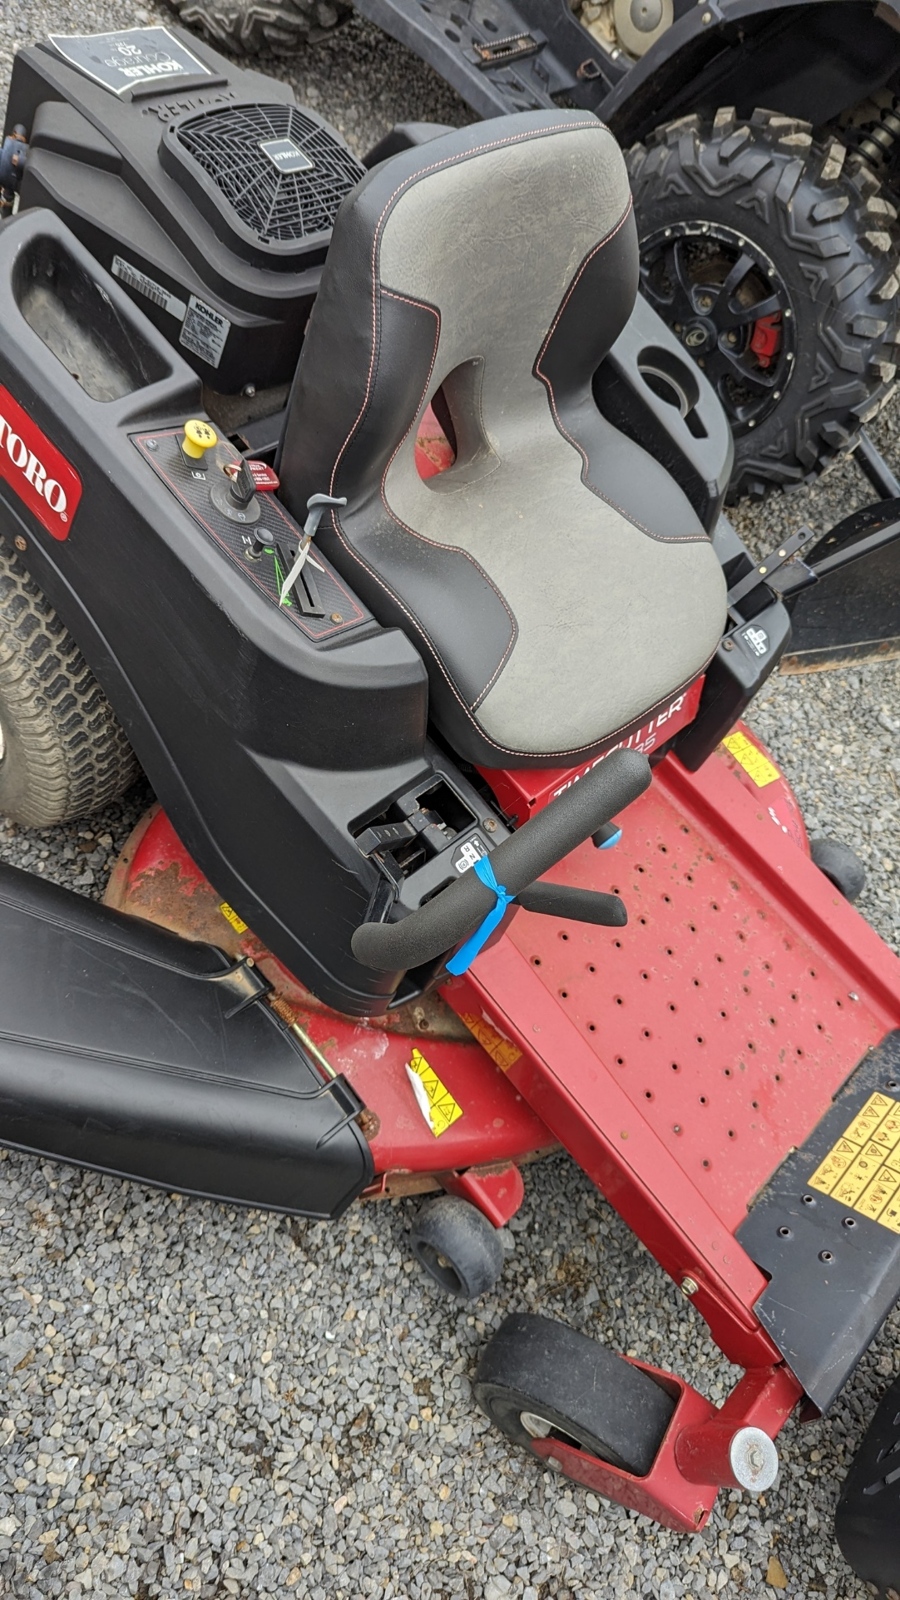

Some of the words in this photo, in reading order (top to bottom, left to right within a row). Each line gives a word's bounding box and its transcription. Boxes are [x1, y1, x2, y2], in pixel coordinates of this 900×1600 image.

[118, 44, 142, 57] 20
[104, 51, 171, 68] Courage
[118, 60, 184, 78] KOHLER
[272, 150, 301, 161] KOHLER
[195, 301, 225, 328] KOHLER
